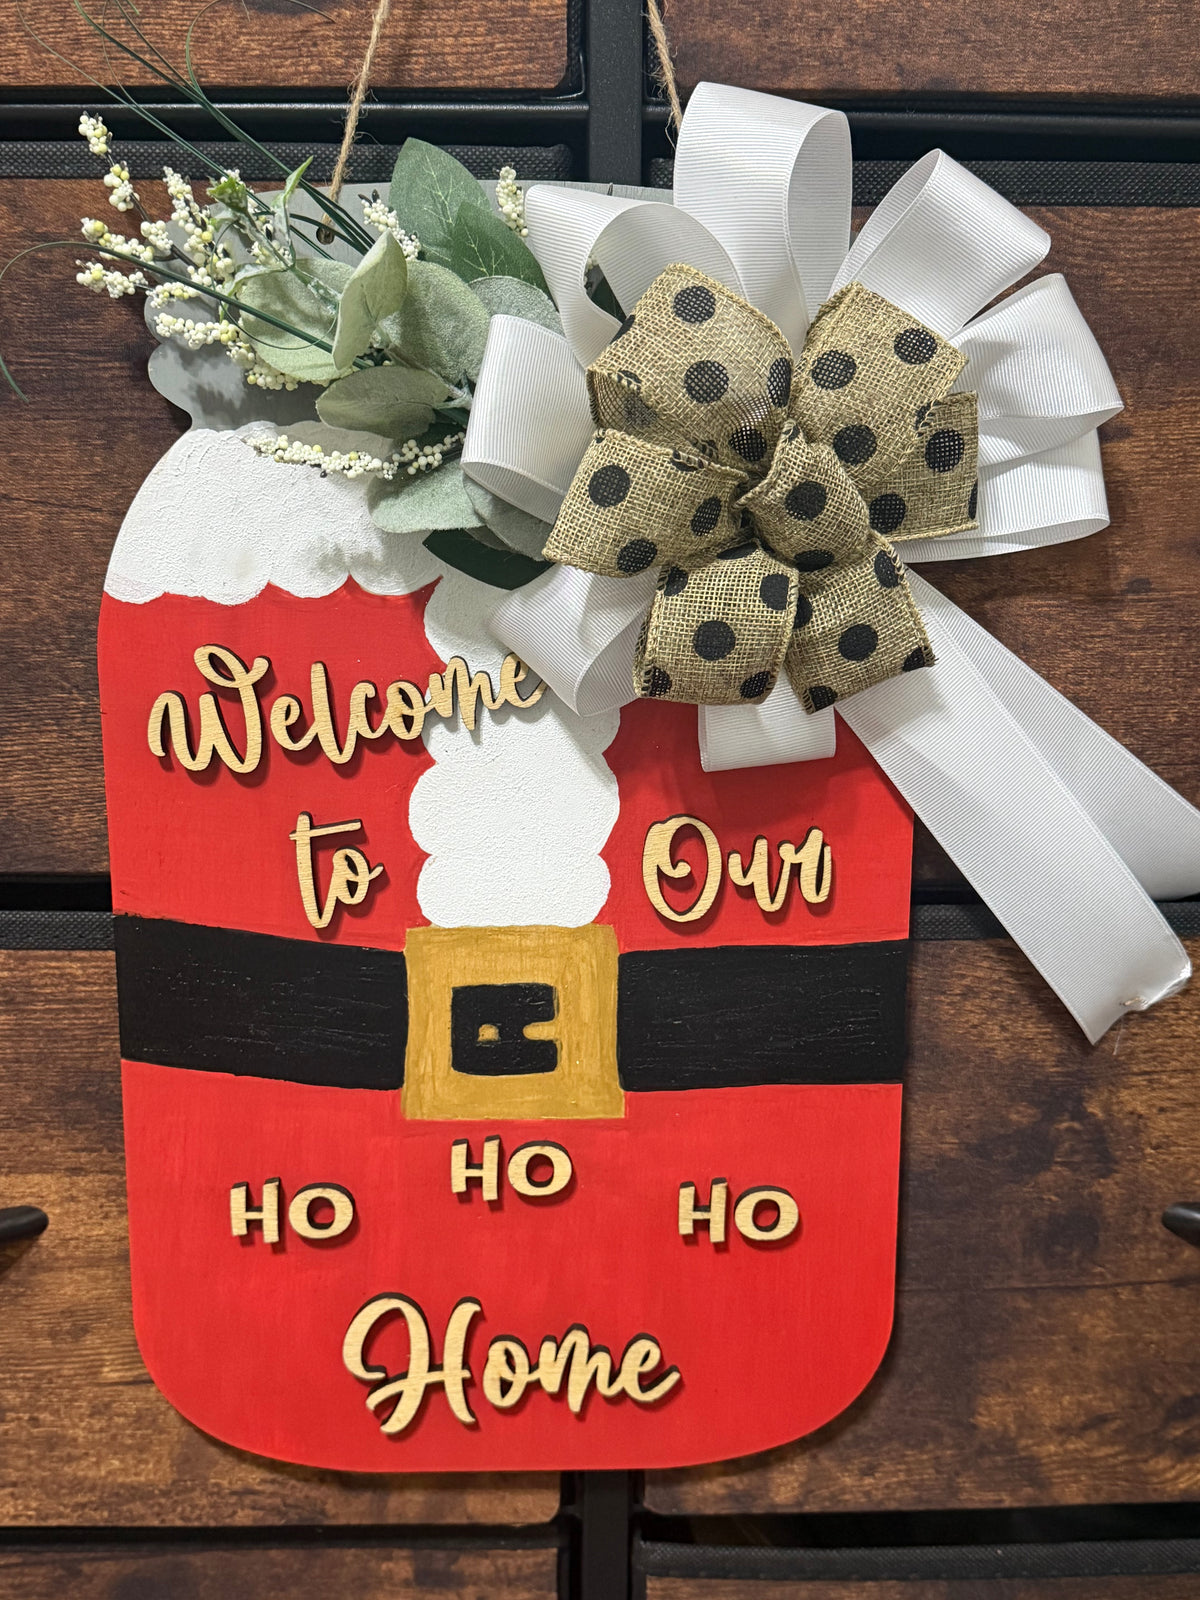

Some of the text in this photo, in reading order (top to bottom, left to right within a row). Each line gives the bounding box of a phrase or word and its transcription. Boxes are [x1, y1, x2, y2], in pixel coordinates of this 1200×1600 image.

[147, 644, 549, 773] Welcome
[289, 811, 832, 929] to Our
[230, 1135, 800, 1244] HO HO HO
[342, 1292, 682, 1435] Home
